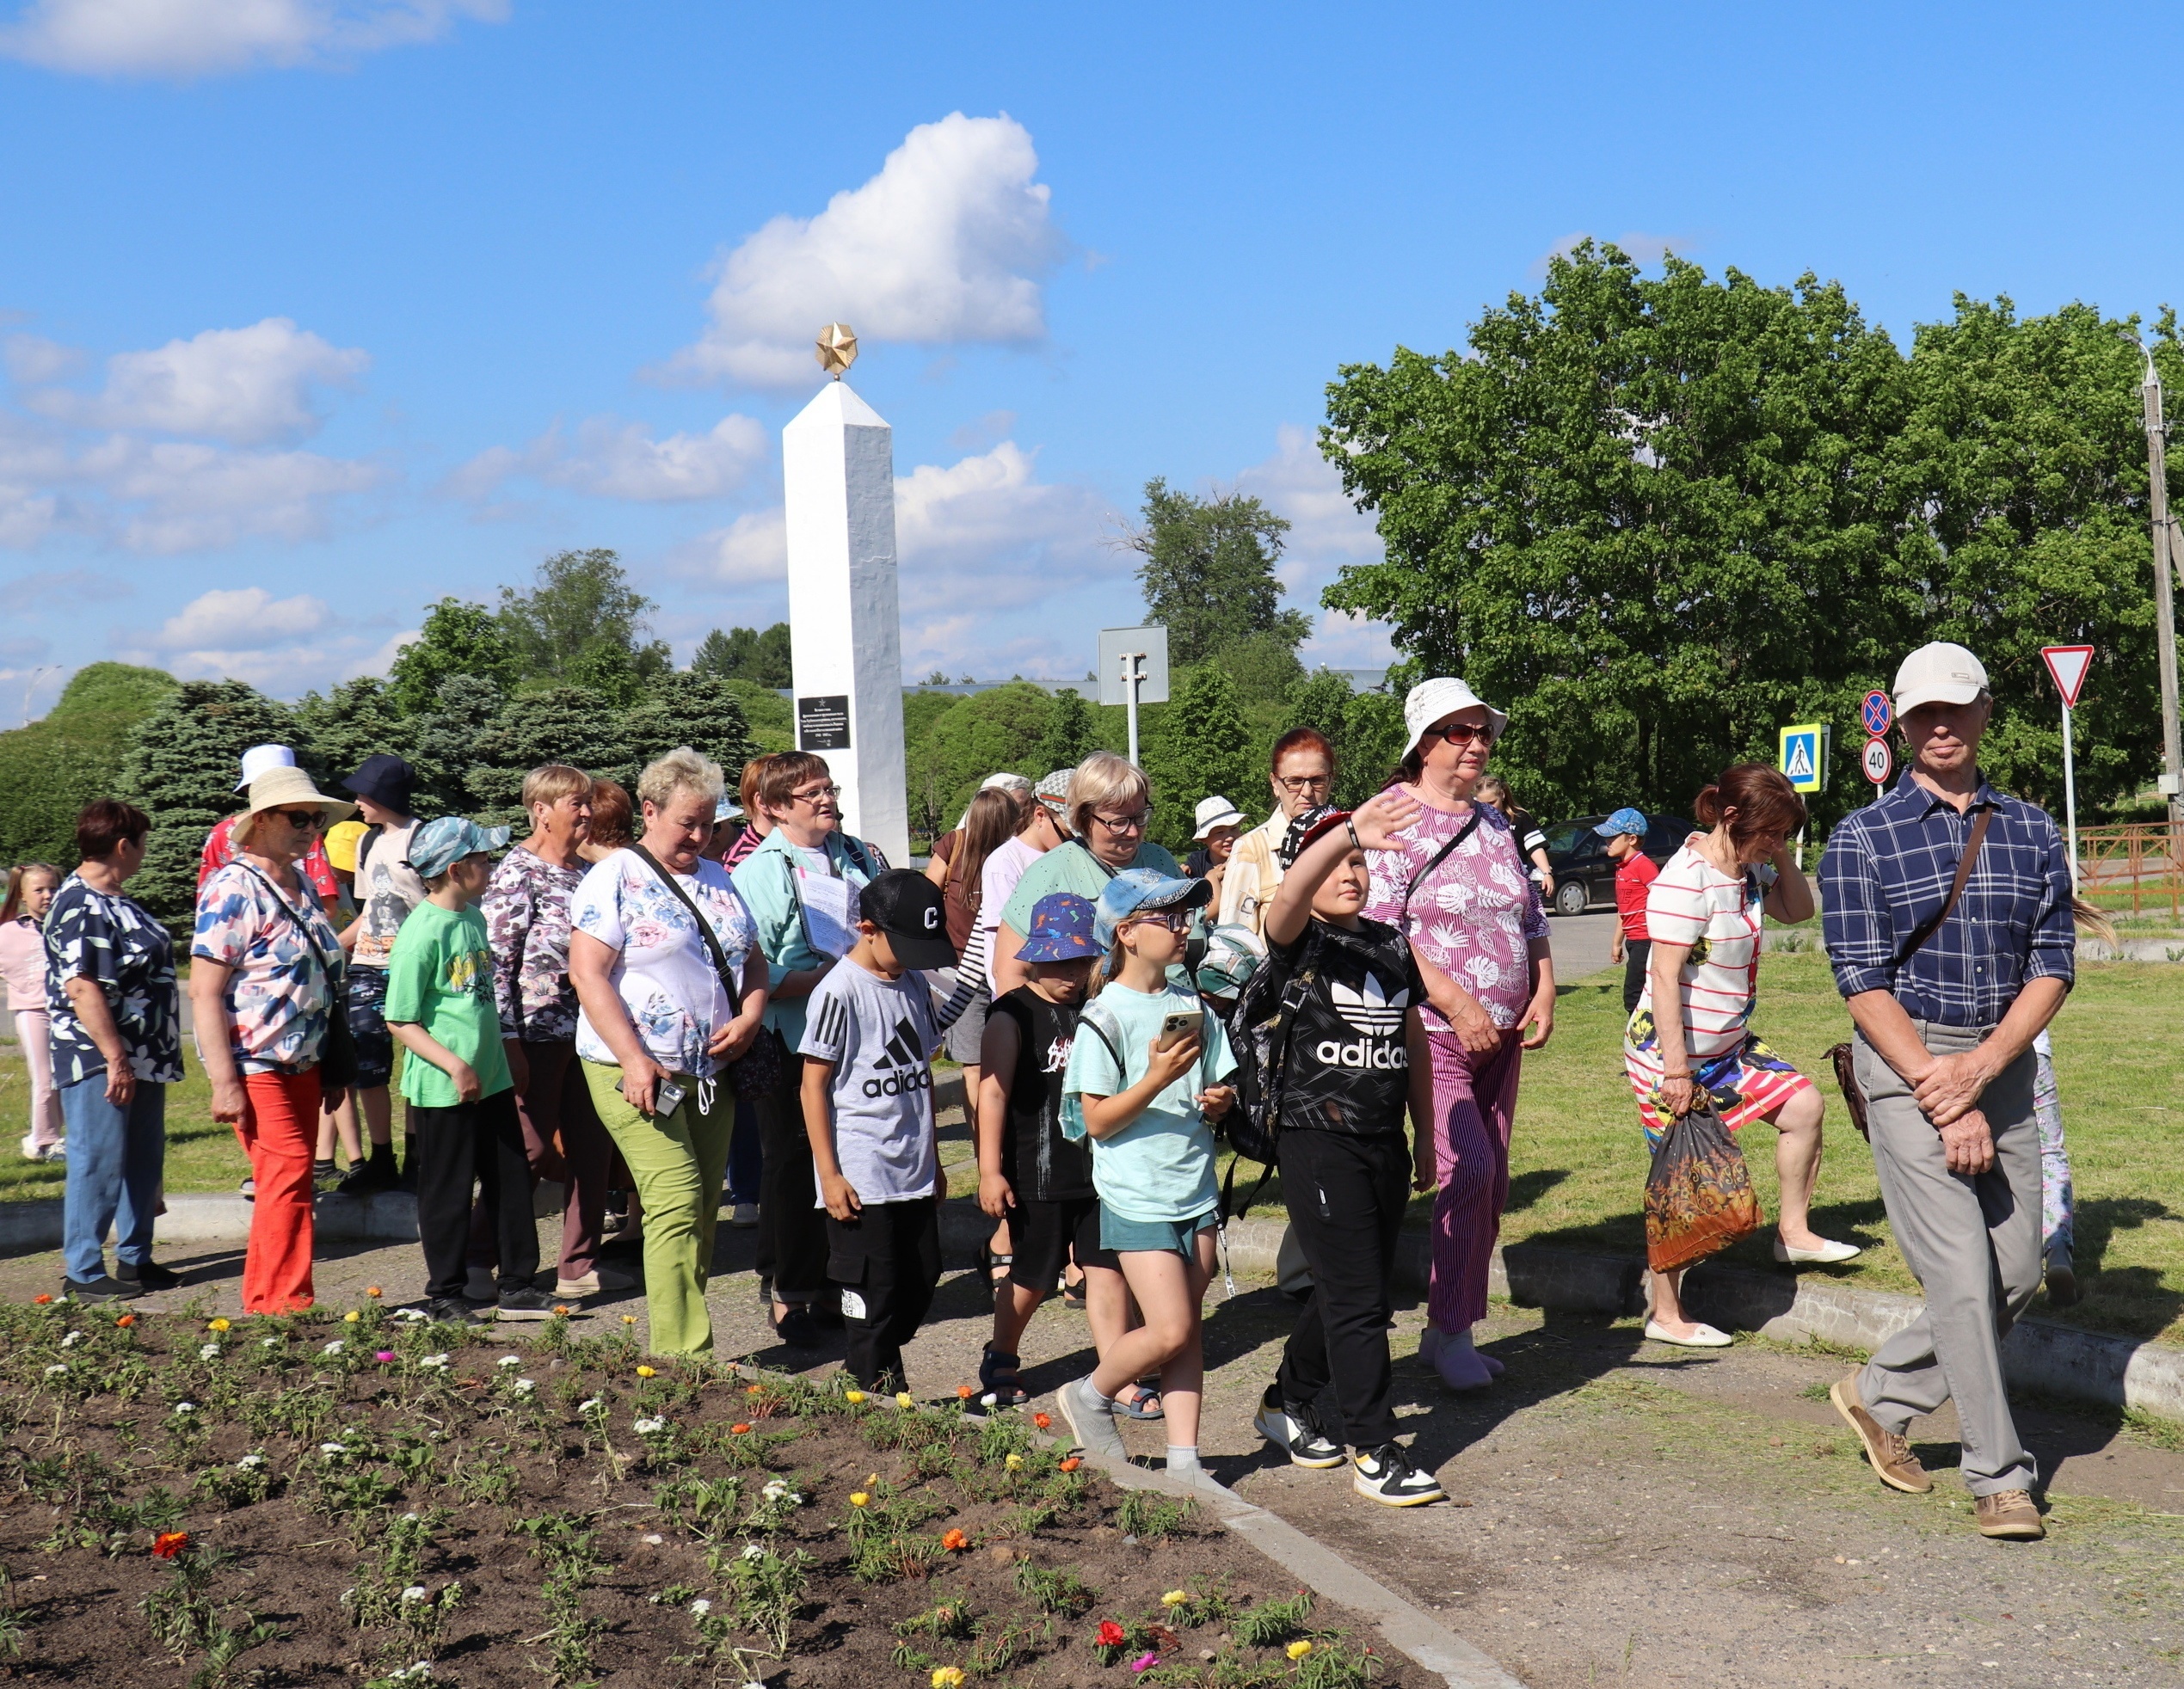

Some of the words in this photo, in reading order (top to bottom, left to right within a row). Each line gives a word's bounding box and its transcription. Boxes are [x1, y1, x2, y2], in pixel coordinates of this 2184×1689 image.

[1869, 752, 1885, 769] 40
[925, 907, 938, 930] C
[862, 1066, 930, 1098] adida
